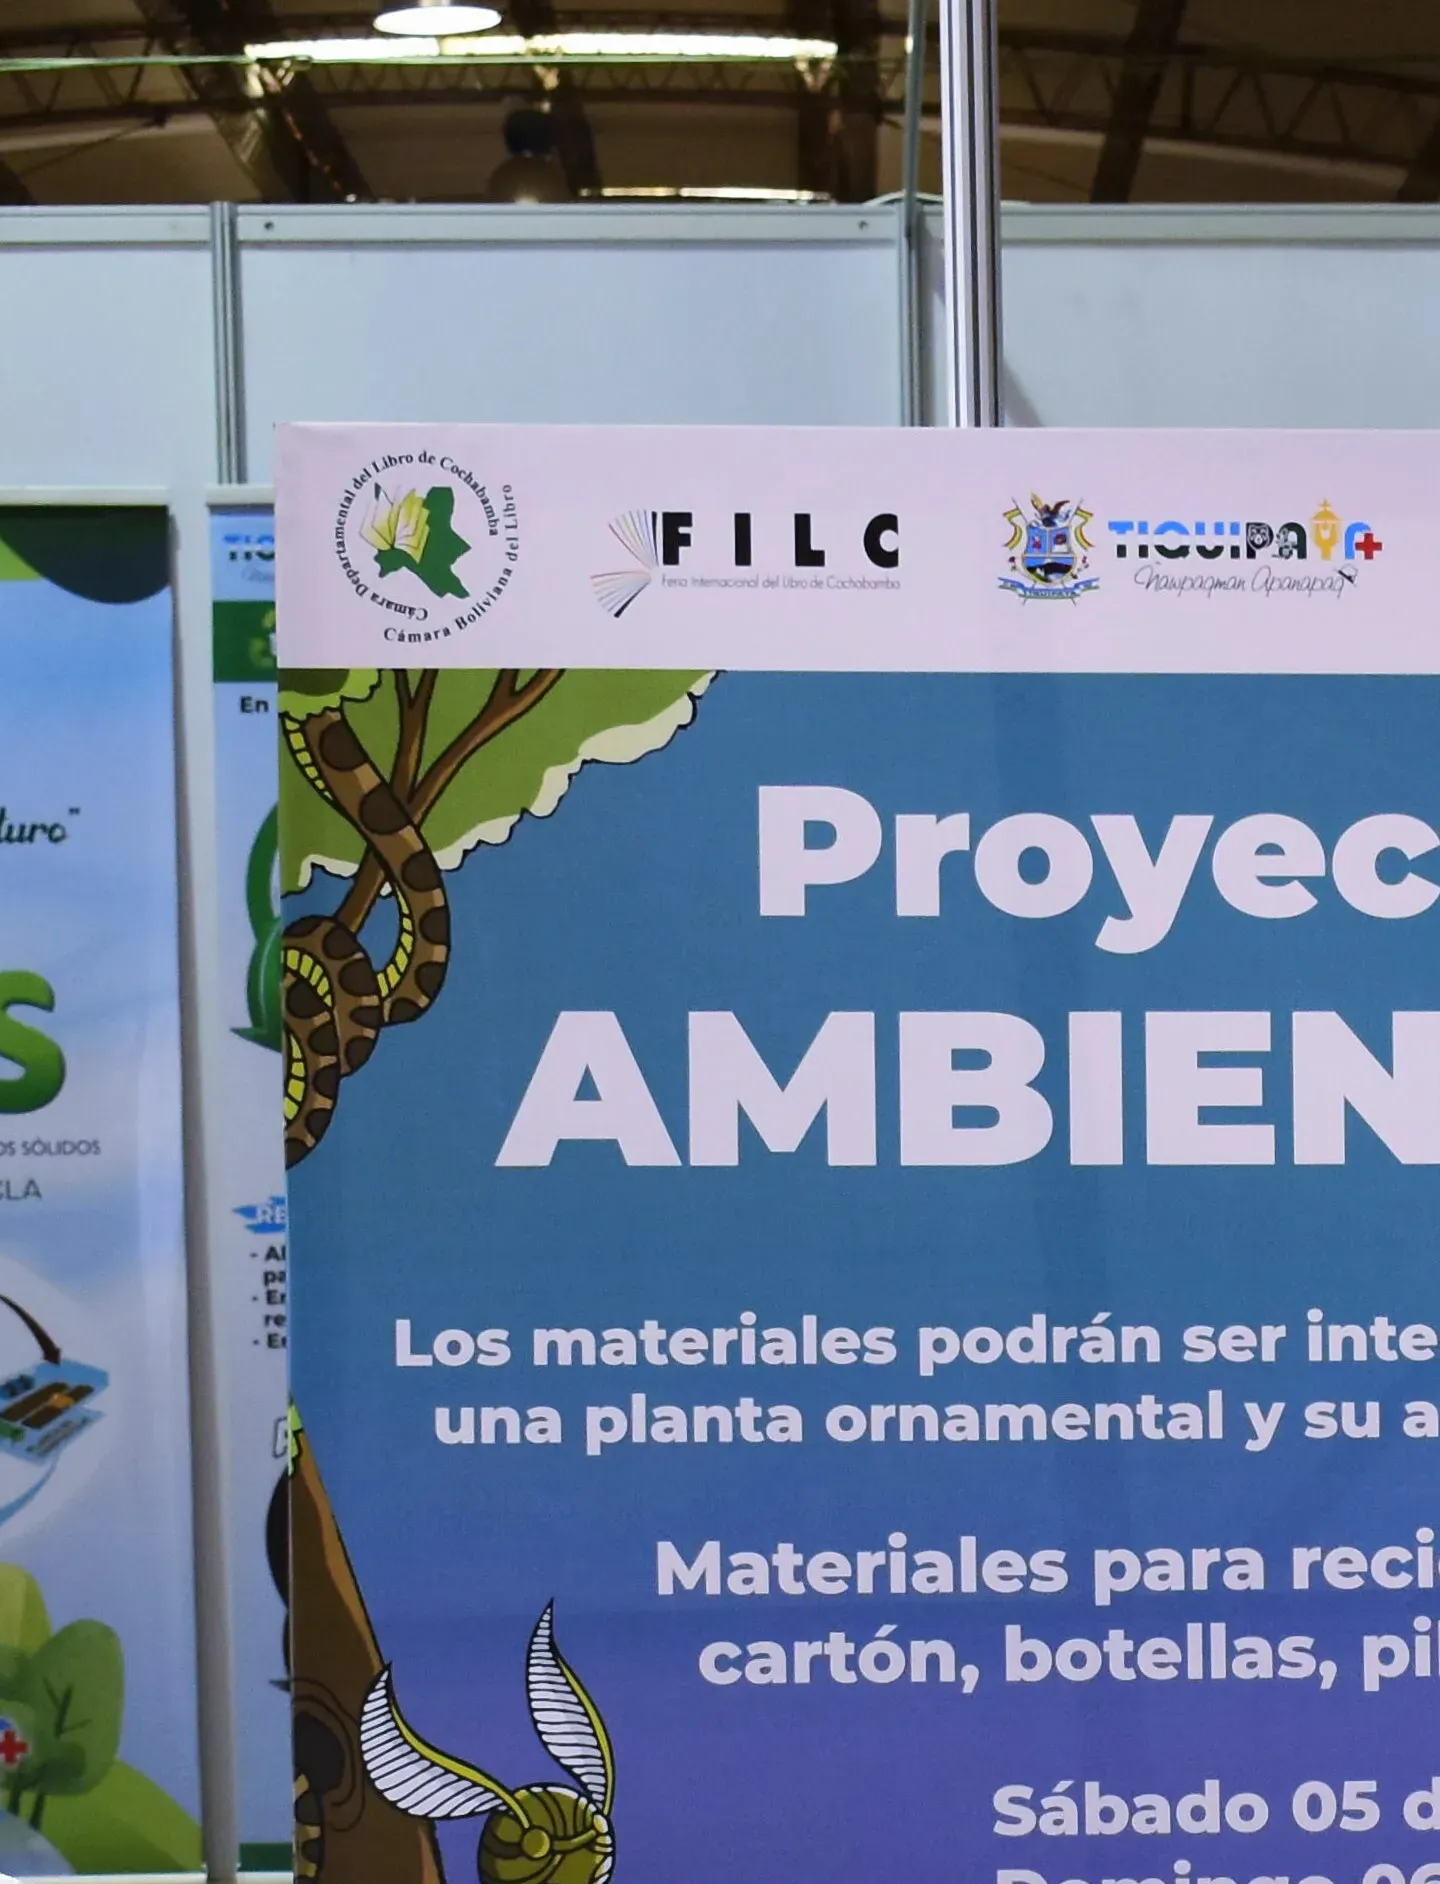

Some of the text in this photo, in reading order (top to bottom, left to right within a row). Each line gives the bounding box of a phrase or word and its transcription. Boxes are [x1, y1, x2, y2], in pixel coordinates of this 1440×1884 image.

[21, 1135, 101, 1157] SÓLIDOS
[392, 1314, 512, 1371] Los
[527, 1311, 897, 1368] materiales
[917, 1309, 1161, 1380] podrán
[1181, 1314, 1287, 1365] ser
[433, 1397, 561, 1448] una
[584, 1388, 803, 1459] planta
[826, 1385, 1224, 1445] ornamental
[1244, 1397, 1284, 1454] y
[1304, 1394, 1380, 1442] su
[653, 1535, 1069, 1598] Materiales
[1092, 1543, 1266, 1606] para
[697, 1627, 979, 1695] cartón,
[1004, 1622, 1339, 1689] botellas,
[993, 1777, 1271, 1838] Sábado
[1291, 1781, 1379, 1833] 05
